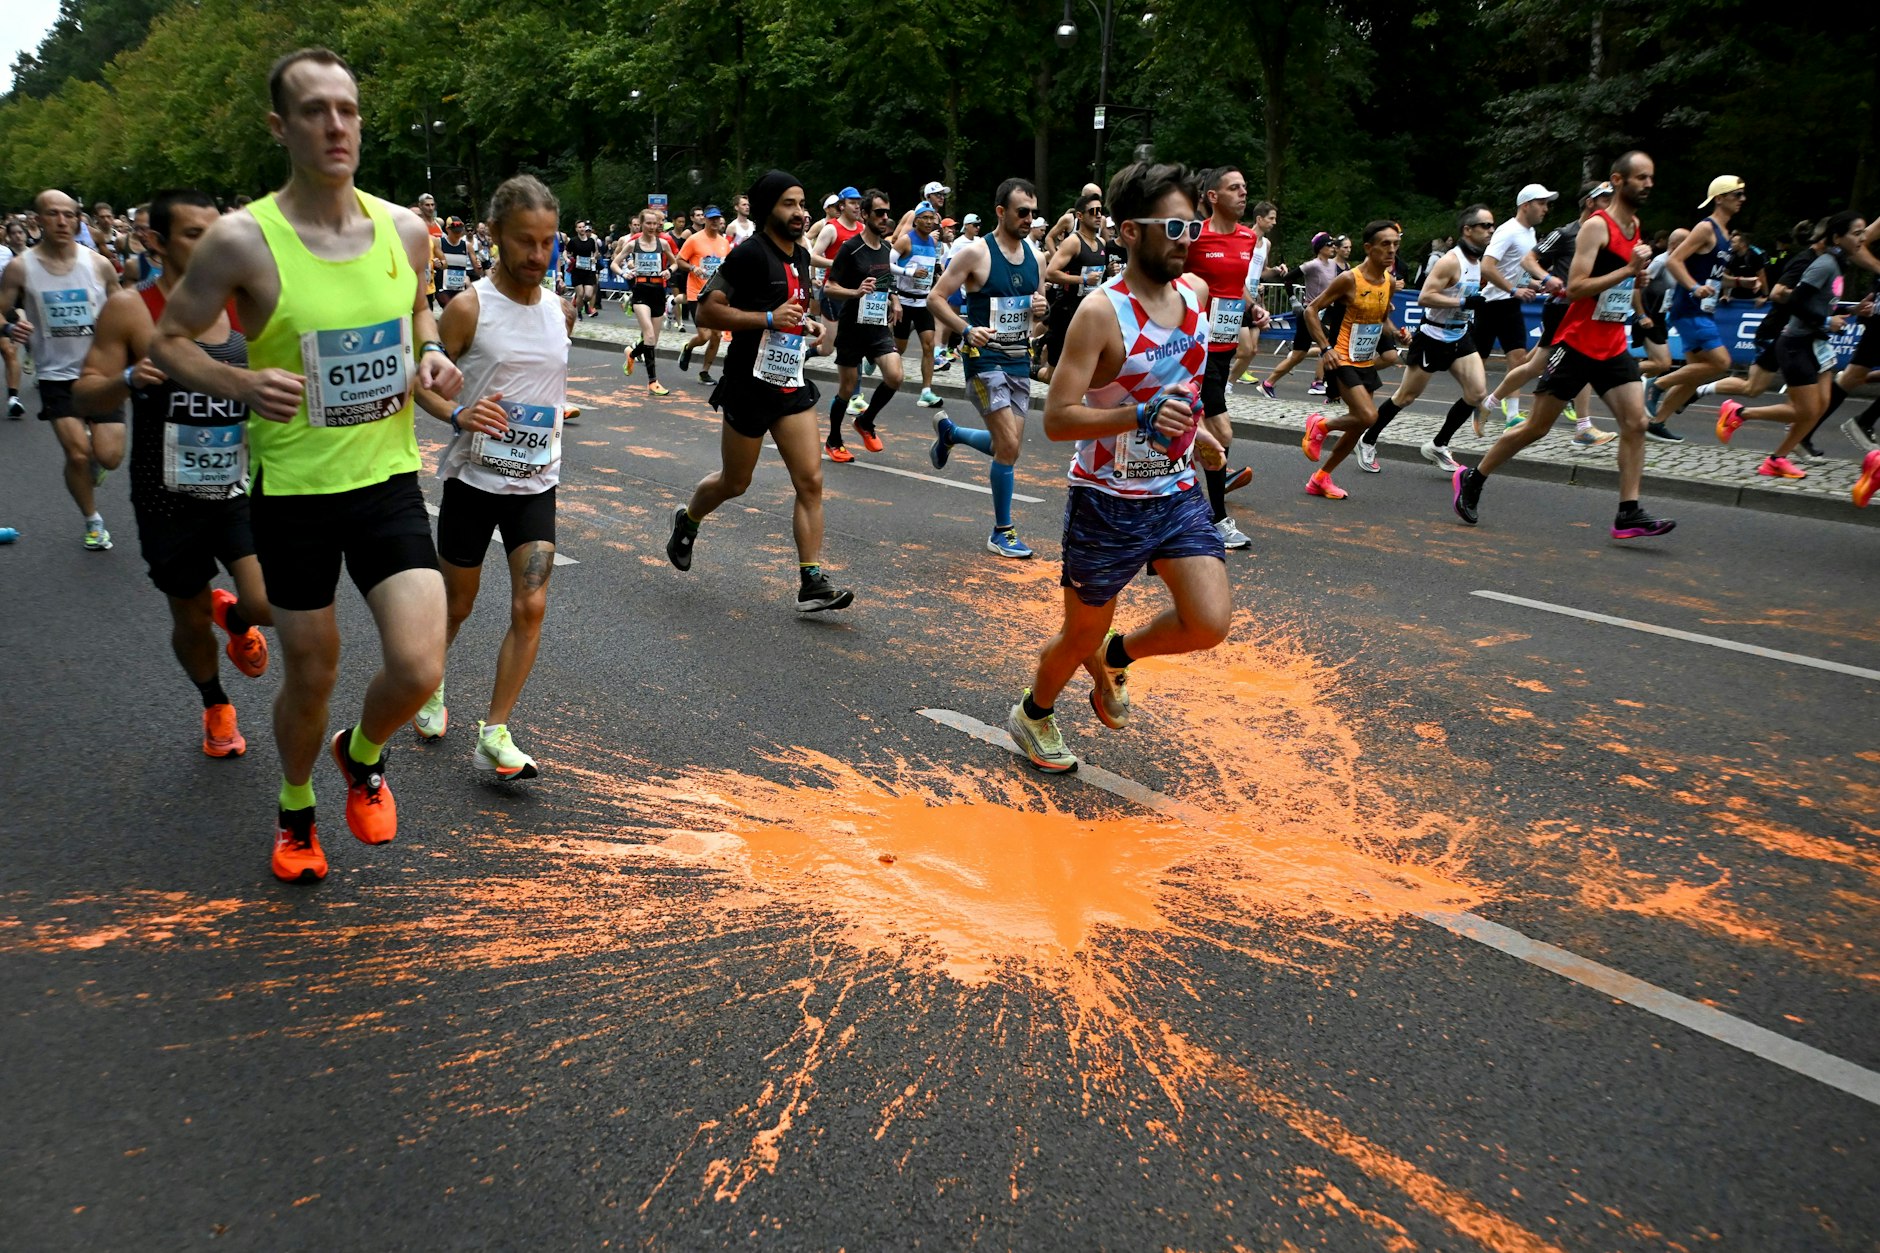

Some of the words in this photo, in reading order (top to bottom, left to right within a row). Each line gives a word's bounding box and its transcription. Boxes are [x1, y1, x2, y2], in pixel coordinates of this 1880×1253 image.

[50, 305, 86, 317] 22731
[1000, 312, 1028, 323] 62819
[1145, 335, 1197, 362] CHICAGO
[767, 349, 799, 365] 33064
[329, 355, 398, 387] 61209
[767, 363, 796, 374] TOMMASO
[340, 384, 393, 402] Cameron
[168, 391, 246, 418] PERU
[327, 400, 384, 417] IMPOSSIBLE
[327, 416, 338, 426] IS
[340, 410, 381, 426] NOTHING
[184, 451, 238, 469] 56221
[510, 448, 527, 459] Rui
[1128, 460, 1171, 469] IMPOSSIBLE
[200, 472, 230, 482] Javier
[491, 466, 525, 479] OTHING
[1127, 470, 1135, 478] IS
[1136, 467, 1169, 477] NOTHING
[190, 491, 227, 501] OTHING
